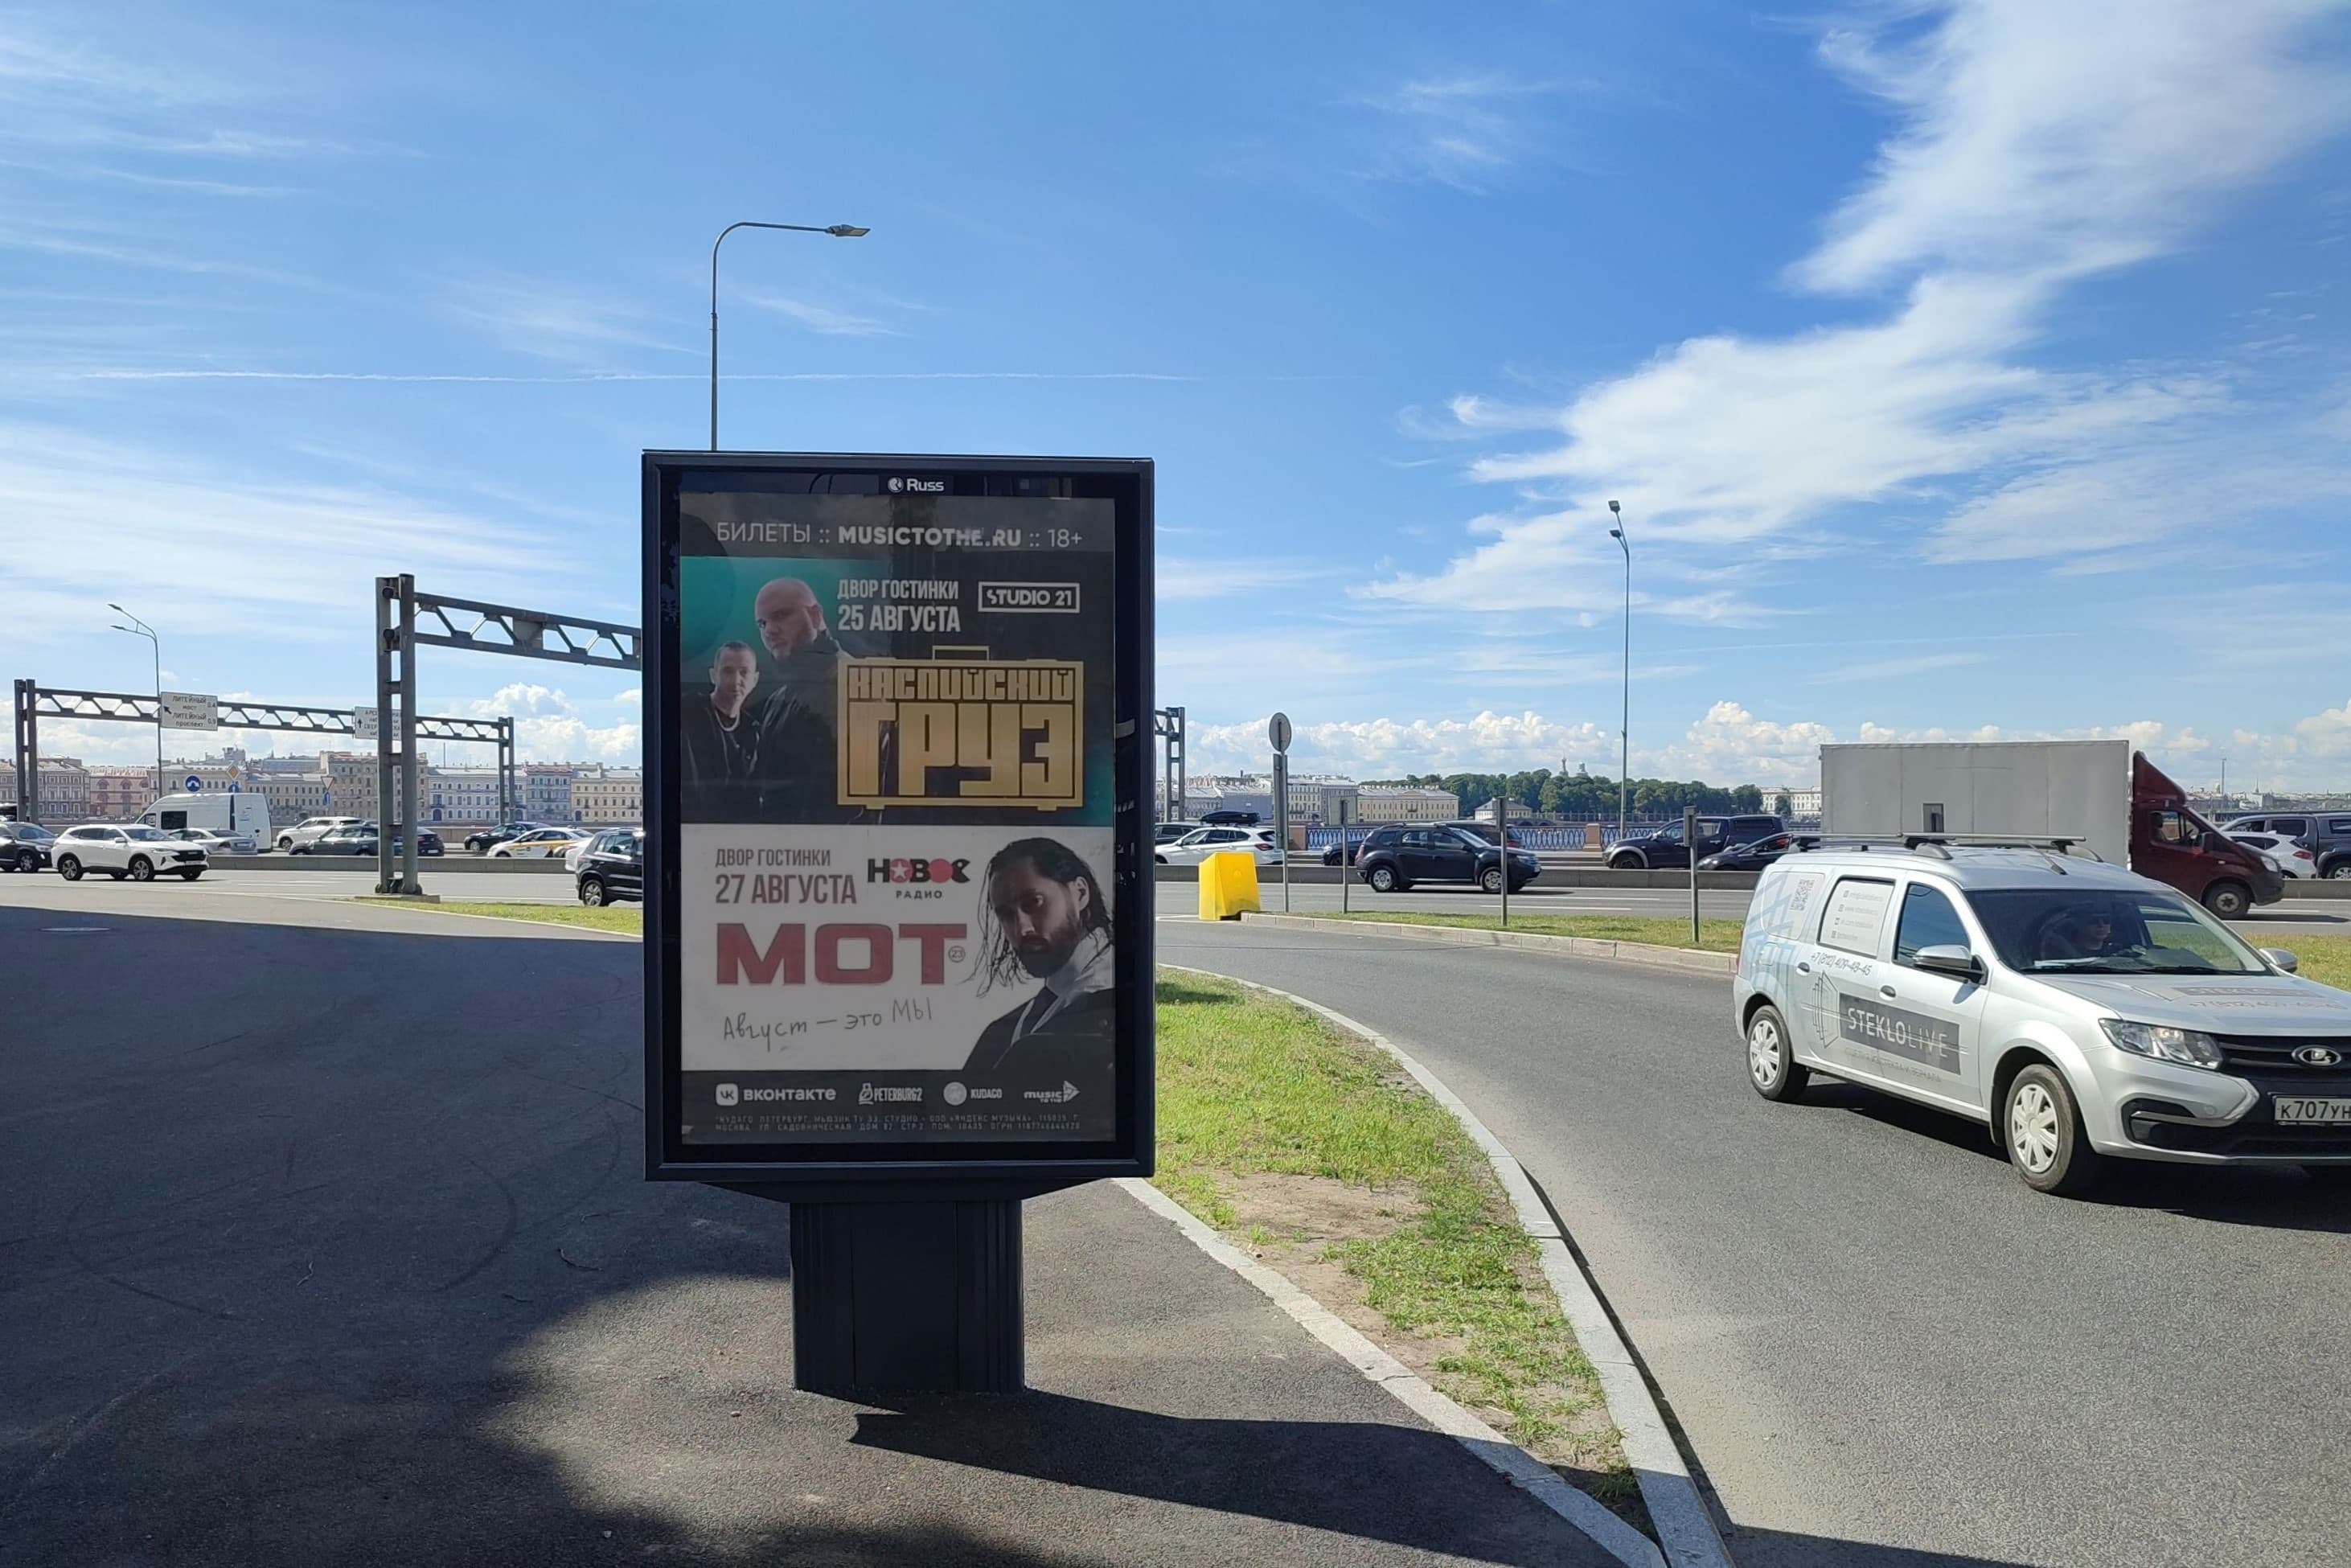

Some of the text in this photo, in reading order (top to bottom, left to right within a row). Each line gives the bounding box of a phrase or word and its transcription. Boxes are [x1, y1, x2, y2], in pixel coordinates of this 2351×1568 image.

[906, 478, 945, 492] Russ
[716, 521, 811, 543] БИЛЕТЫ
[838, 525, 1022, 547] MUSICTOTHE.RU
[1047, 528, 1083, 548] 18+
[837, 578, 959, 600] ДВОР ГОСТИНКИ
[986, 589, 1073, 606] STUDIO 21
[837, 604, 962, 633] 25 АВГУСТА
[848, 667, 1074, 701] КАСПИЙСКИЙ
[848, 701, 1074, 797] ГРУЗ
[715, 848, 831, 868] ДВОР ГОСТИНКИ
[715, 873, 858, 905] 27 АВГУСТА
[896, 890, 943, 900] РАДИО
[716, 922, 968, 986] МОТ
[723, 1012, 808, 1053] Август
[844, 1014, 882, 1030] это
[970, 1088, 1003, 1099] KUDAGO
